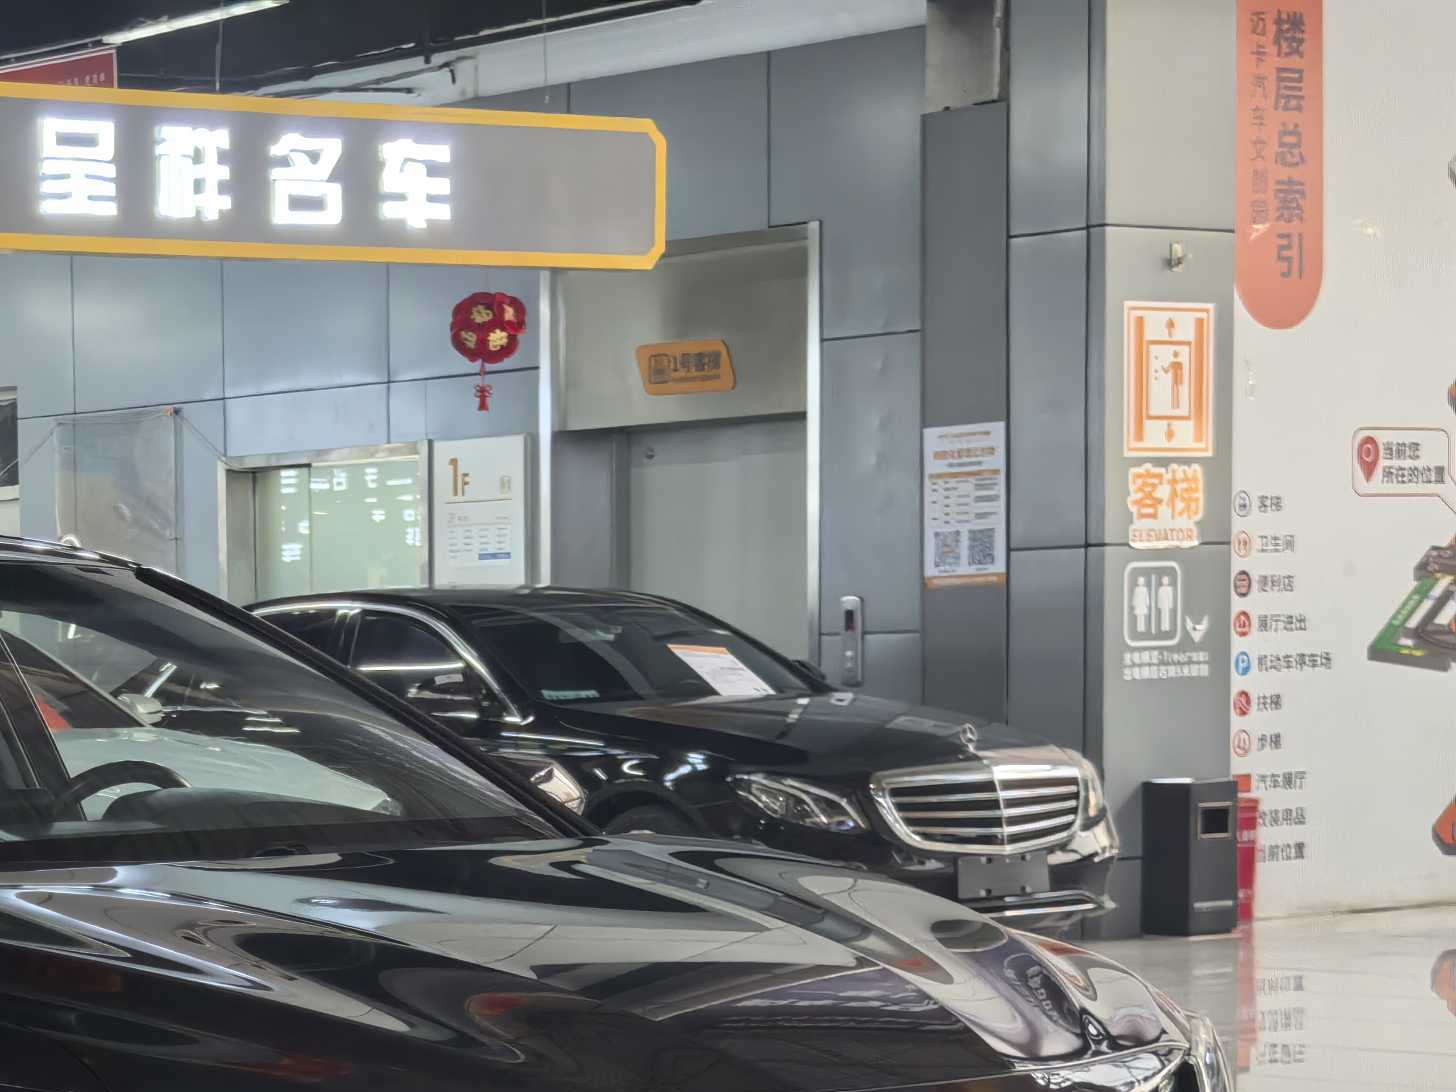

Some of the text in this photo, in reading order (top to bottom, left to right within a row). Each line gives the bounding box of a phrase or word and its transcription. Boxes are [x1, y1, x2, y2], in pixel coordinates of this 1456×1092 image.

[1273, 9, 1307, 280] 楼层总索引
[38, 116, 452, 229] 呈祥名车
[1131, 466, 1202, 520] 客梯
[1131, 527, 1196, 543] ELEVATOR
[1257, 534, 1296, 553] 卫生间
[1255, 770, 1307, 791] 汽车展厅
